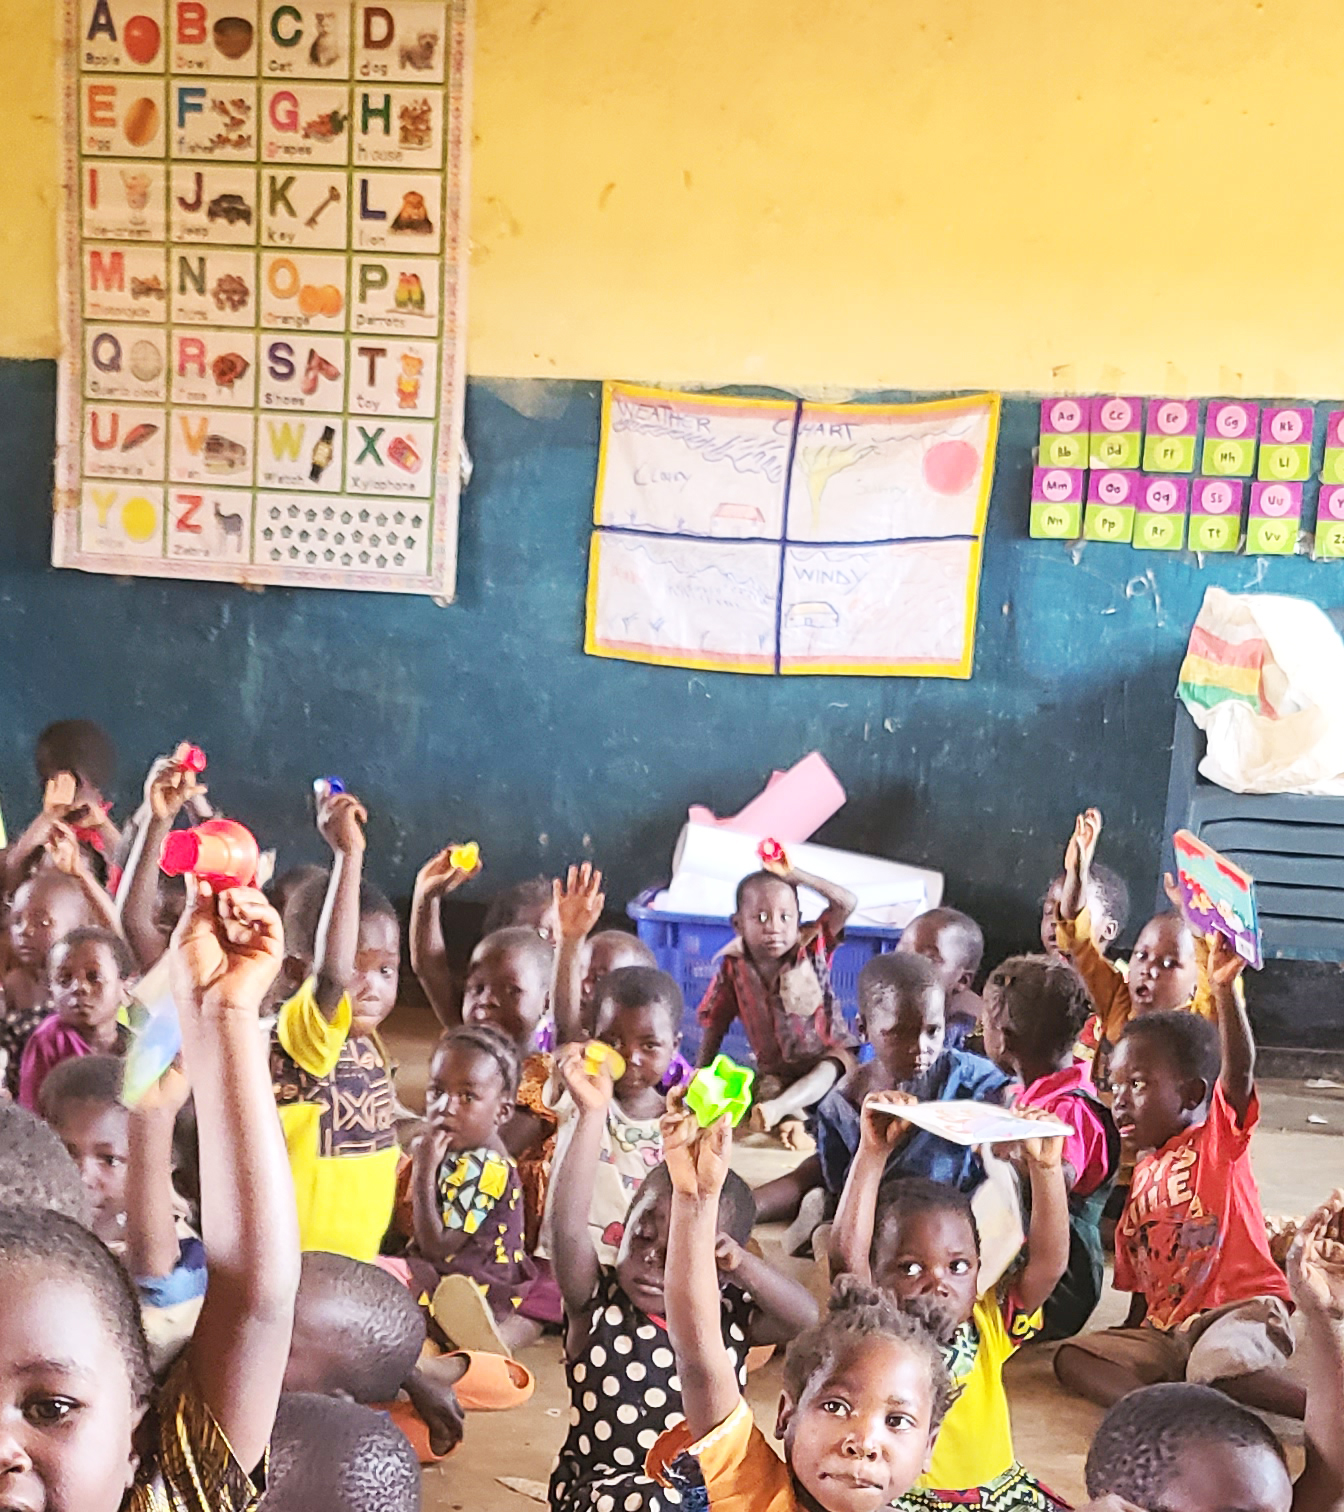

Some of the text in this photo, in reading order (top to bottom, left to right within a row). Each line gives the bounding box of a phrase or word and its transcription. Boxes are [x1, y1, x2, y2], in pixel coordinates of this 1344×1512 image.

[87, 0, 117, 42] A
[177, 2, 208, 45] B
[271, 5, 303, 47] C
[363, 7, 395, 50] D
[88, 85, 116, 128] E
[178, 88, 207, 128] F
[269, 90, 299, 132] G
[361, 93, 391, 136] H
[89, 168, 98, 210] I
[177, 172, 203, 212] J
[269, 175, 298, 218] K
[360, 178, 386, 220] L
[90, 251, 125, 292] M
[178, 256, 206, 295] N
[268, 258, 299, 299] O
[359, 264, 388, 304] P
[92, 332, 122, 373] Q
[178, 337, 206, 378] R
[268, 341, 295, 381] S
[357, 346, 387, 387] T
[91, 411, 119, 451] U
[616, 399, 710, 433] WEATHER
[1109, 410, 1124, 421] Cc
[1166, 413, 1179, 423] Ee
[1224, 416, 1239, 429] Gg
[180, 416, 209, 456] V
[267, 420, 305, 462] W
[355, 426, 385, 466] X
[1107, 444, 1122, 456] Dd
[1046, 481, 1068, 491] Mm
[1105, 483, 1121, 494] Oo
[1152, 491, 1170, 505] Qq
[1210, 492, 1223, 503] Ss
[1267, 495, 1284, 506] Uu
[91, 489, 117, 529] Y
[176, 494, 203, 534] Z
[1047, 515, 1063, 526] Nn
[1101, 518, 1116, 532] Pp
[1151, 526, 1166, 537] Rr
[1208, 528, 1221, 538] Tt
[1264, 531, 1281, 542] Vv
[792, 565, 867, 596] WINDY
